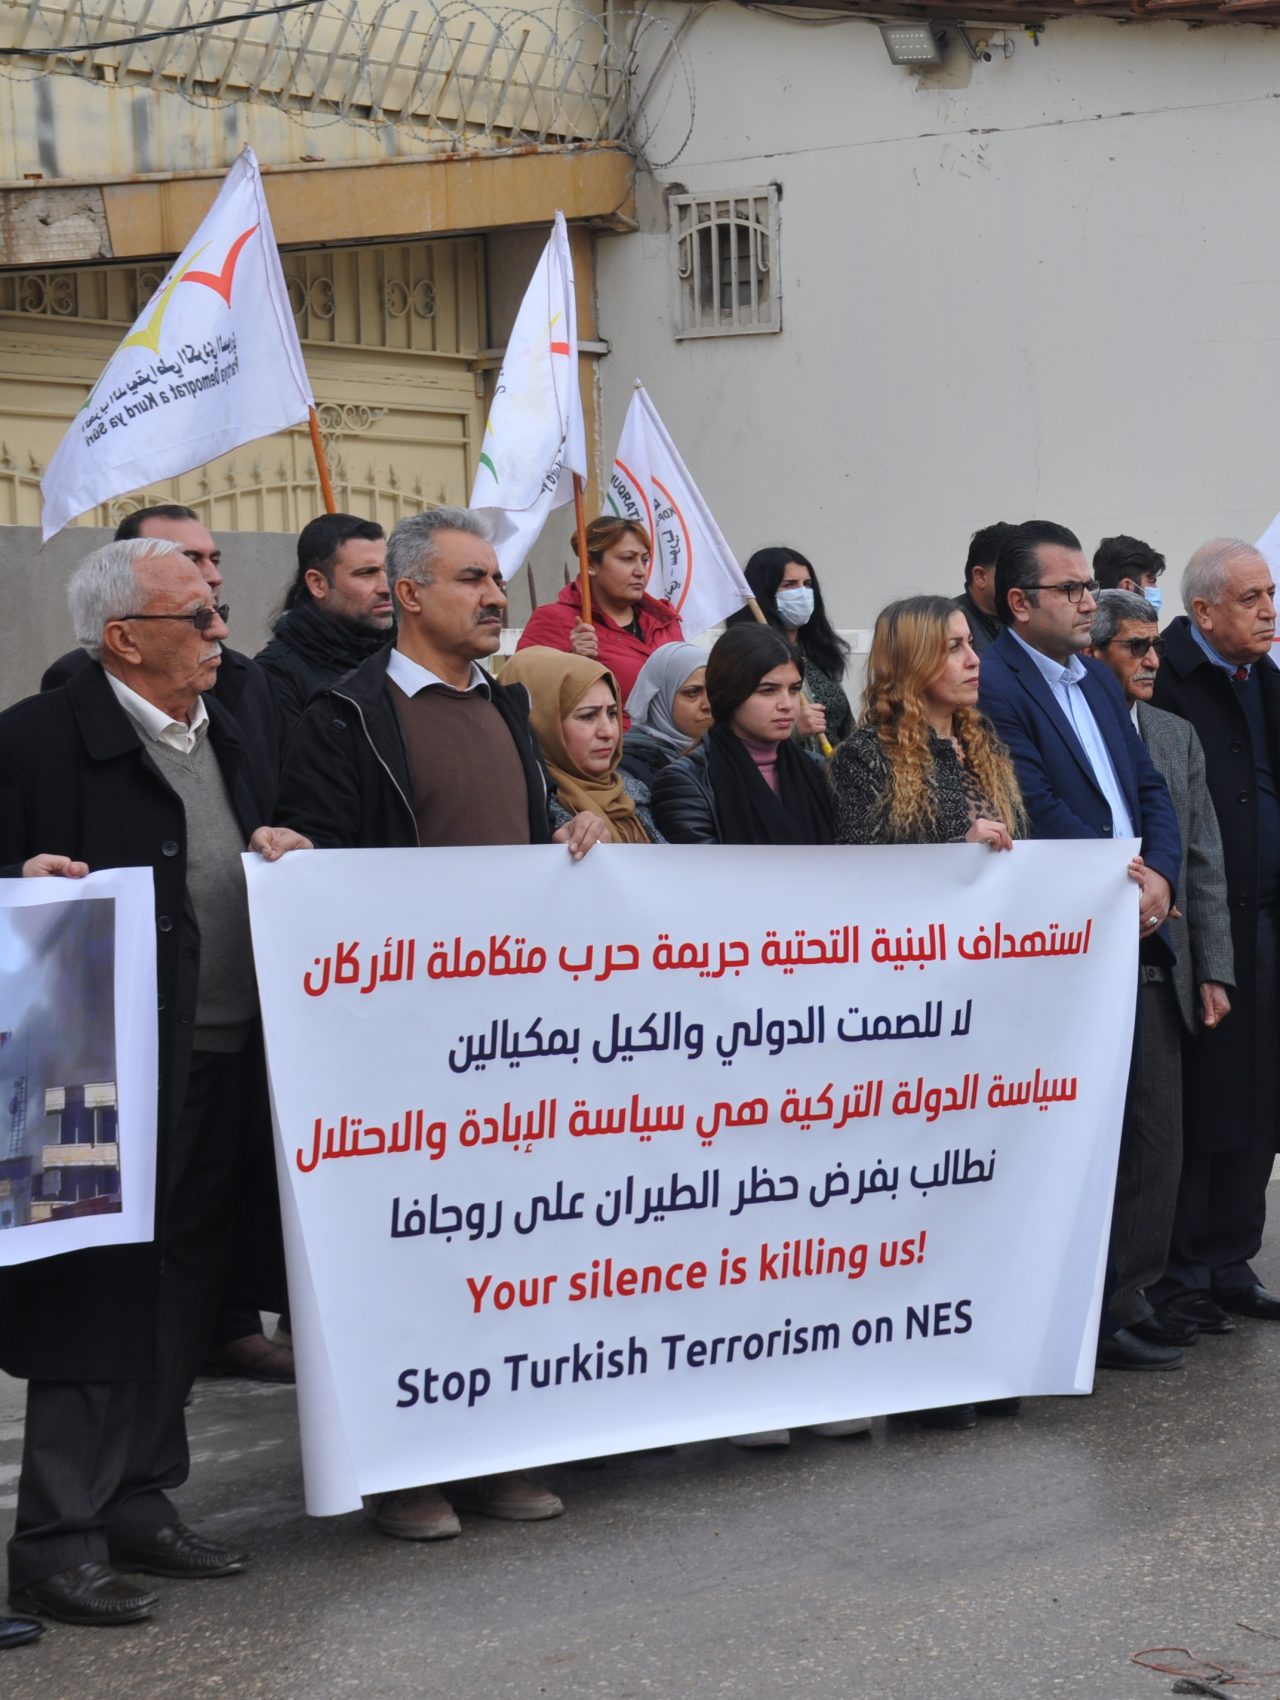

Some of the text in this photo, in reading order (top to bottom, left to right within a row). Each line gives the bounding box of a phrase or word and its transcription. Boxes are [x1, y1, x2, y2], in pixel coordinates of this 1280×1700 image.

[303, 918, 1093, 998] استهداف البنية التحتية جريمة حرب متكاملة الأركان
[448, 998, 973, 1074] لا للصمت الدولي والكيل بمكيالين
[295, 1067, 1078, 1174] سياسة الدولة التركية هي سياسة الإبادة والاحتلال
[390, 1147, 997, 1244] نطالب بفرض حظر الطيران على روجافا
[465, 1229, 927, 1314] Your silence is killing us!
[395, 1299, 973, 1409] Stop Turkish Terrorism on NES
